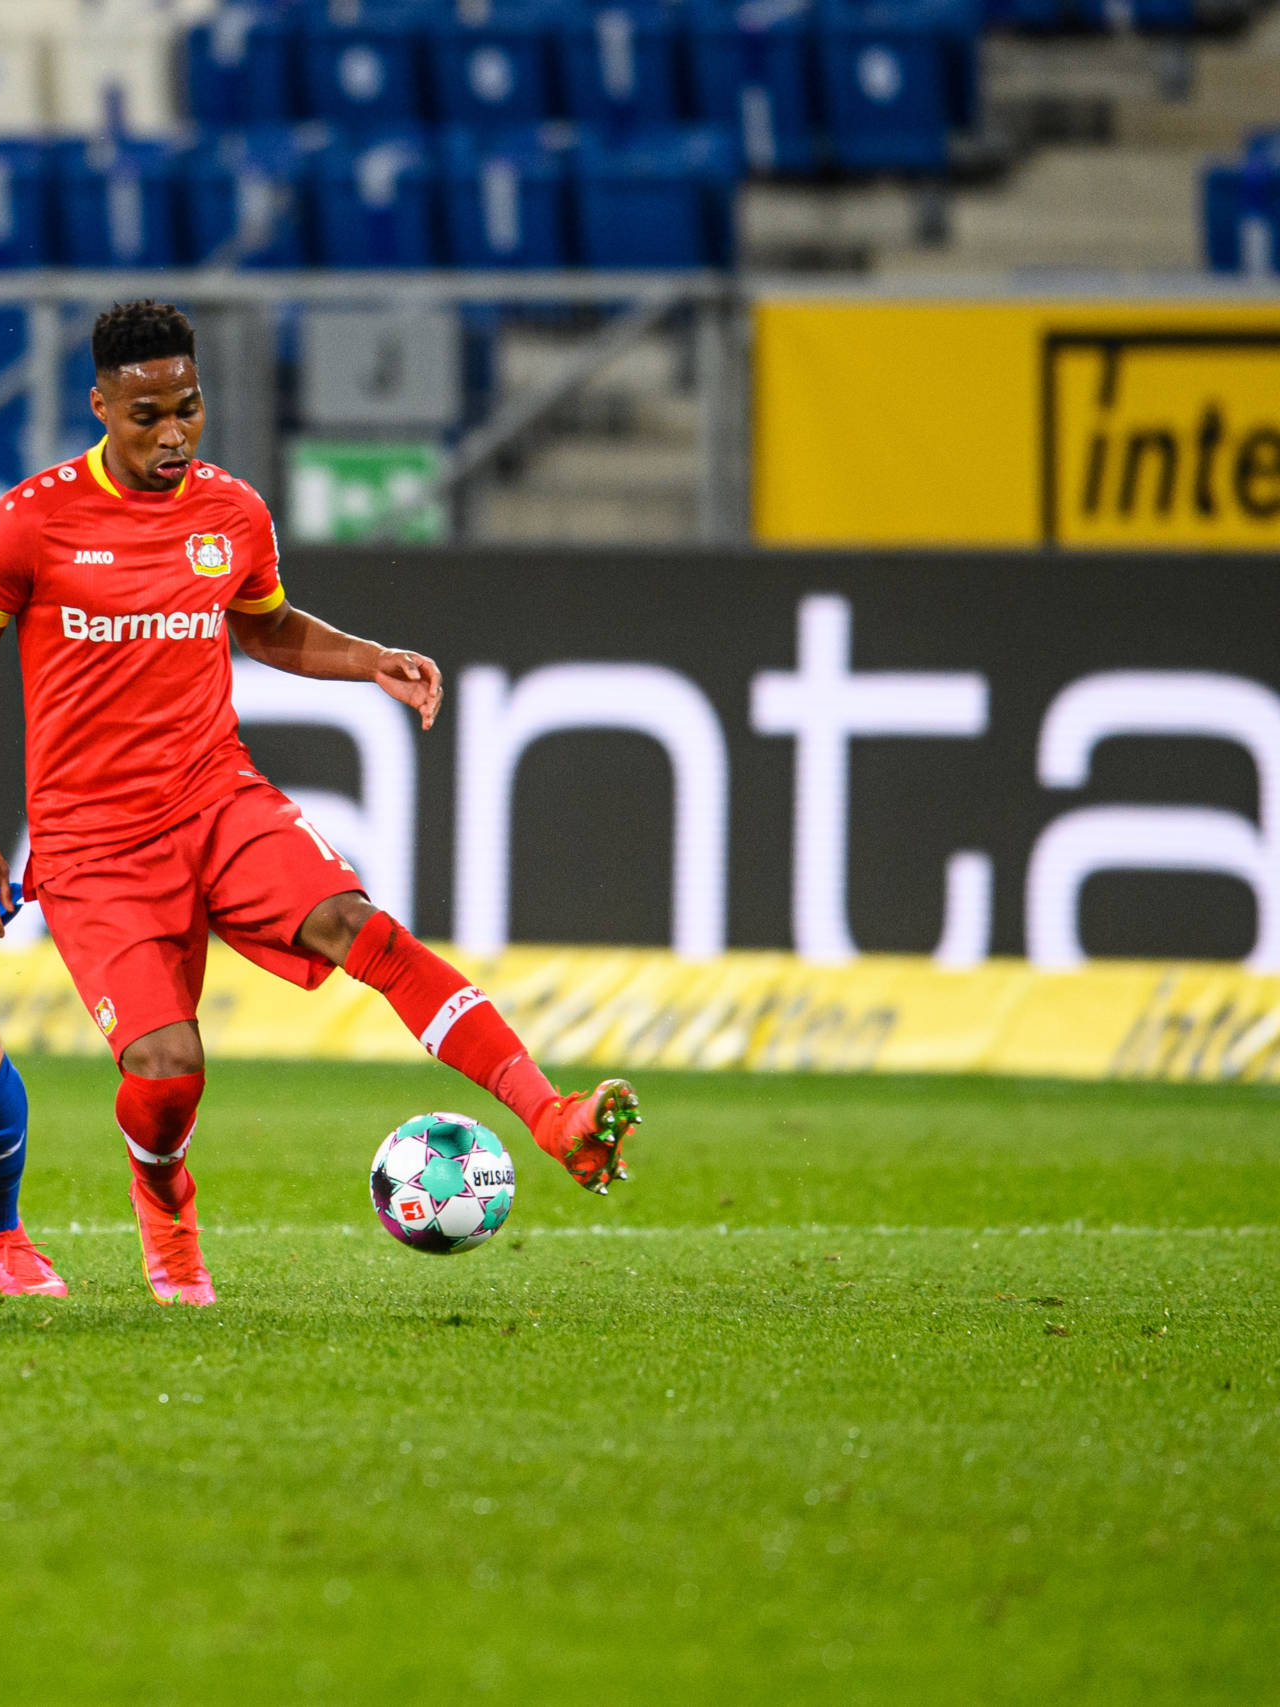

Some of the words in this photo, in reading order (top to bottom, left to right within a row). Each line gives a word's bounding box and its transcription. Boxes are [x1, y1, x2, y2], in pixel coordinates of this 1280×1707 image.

[73, 550, 115, 565] JAKO
[293, 816, 355, 873] 1
[447, 987, 487, 1019] JAK
